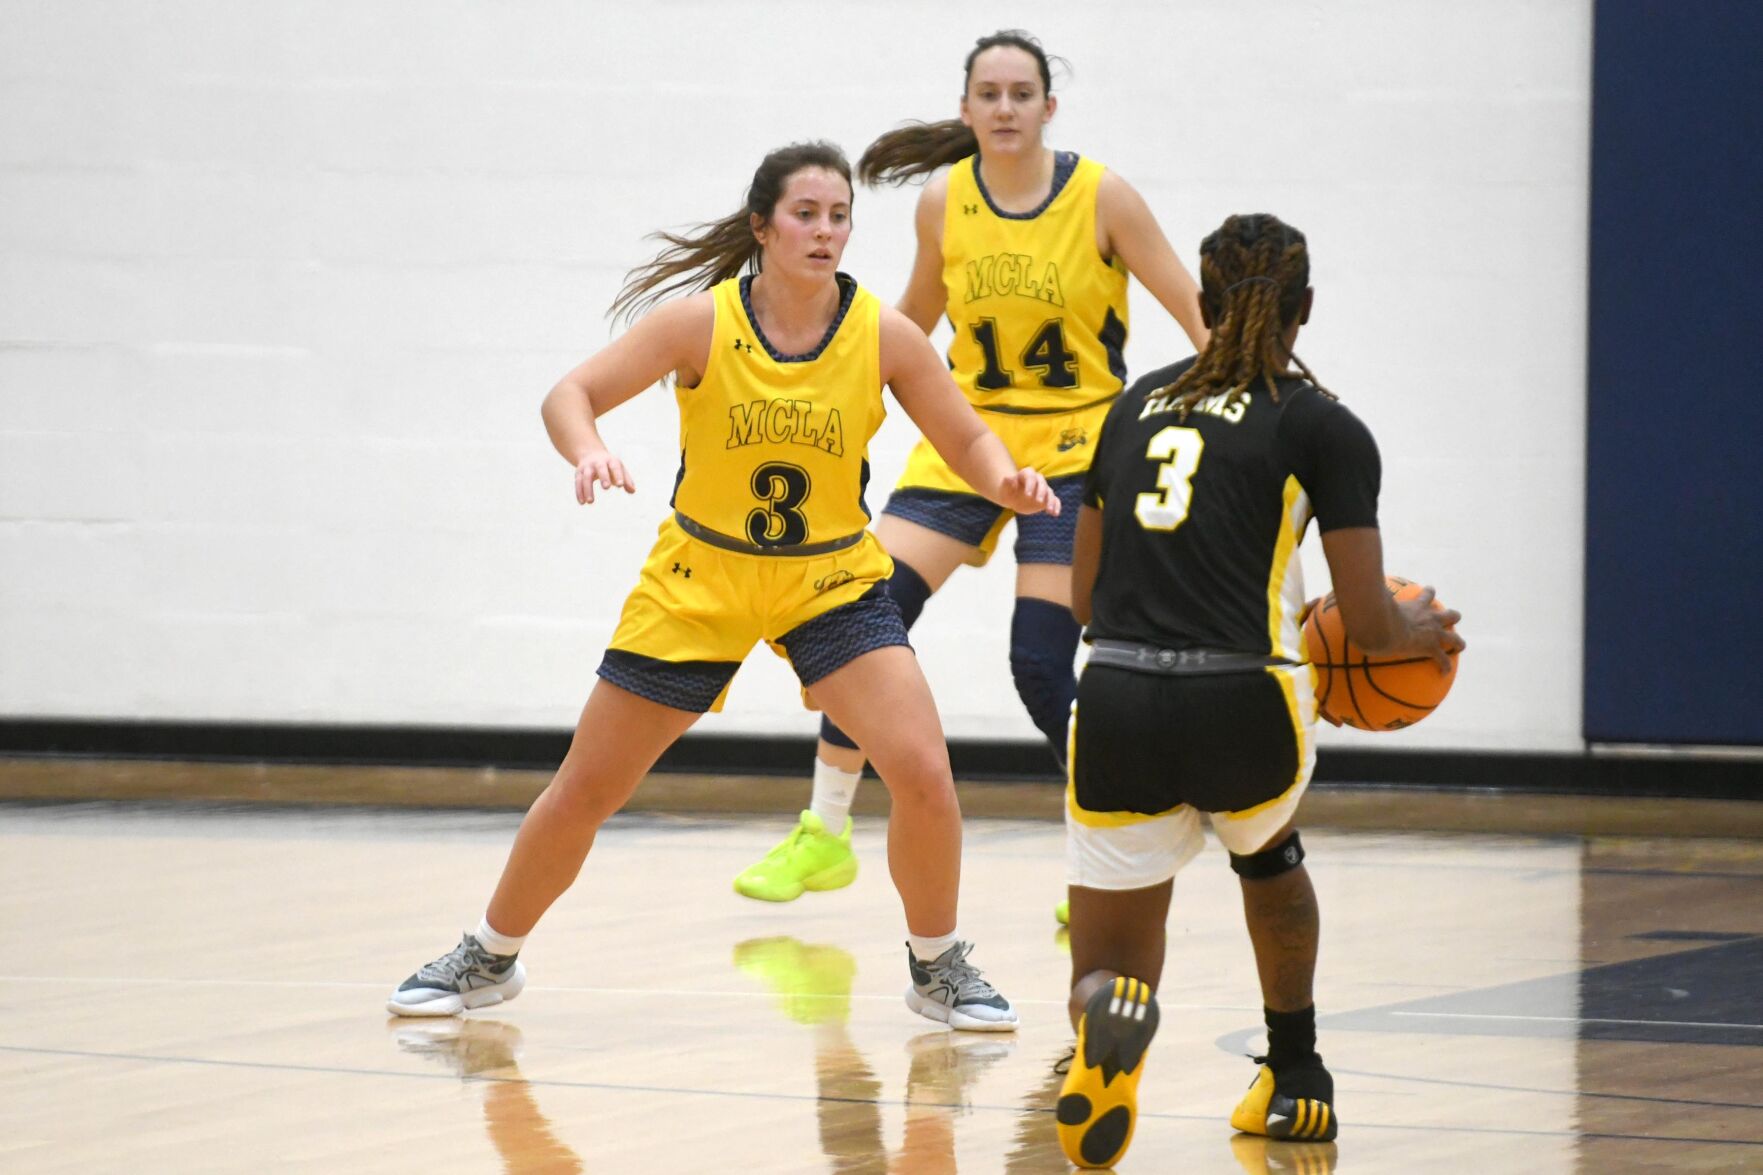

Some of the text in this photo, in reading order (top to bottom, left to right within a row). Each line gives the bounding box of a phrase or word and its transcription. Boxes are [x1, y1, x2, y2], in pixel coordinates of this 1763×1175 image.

[964, 253, 1064, 308] MCLA
[969, 316, 1080, 391] 14
[726, 398, 844, 458] MCLA
[745, 461, 811, 547] 3
[1134, 425, 1205, 531] 3
